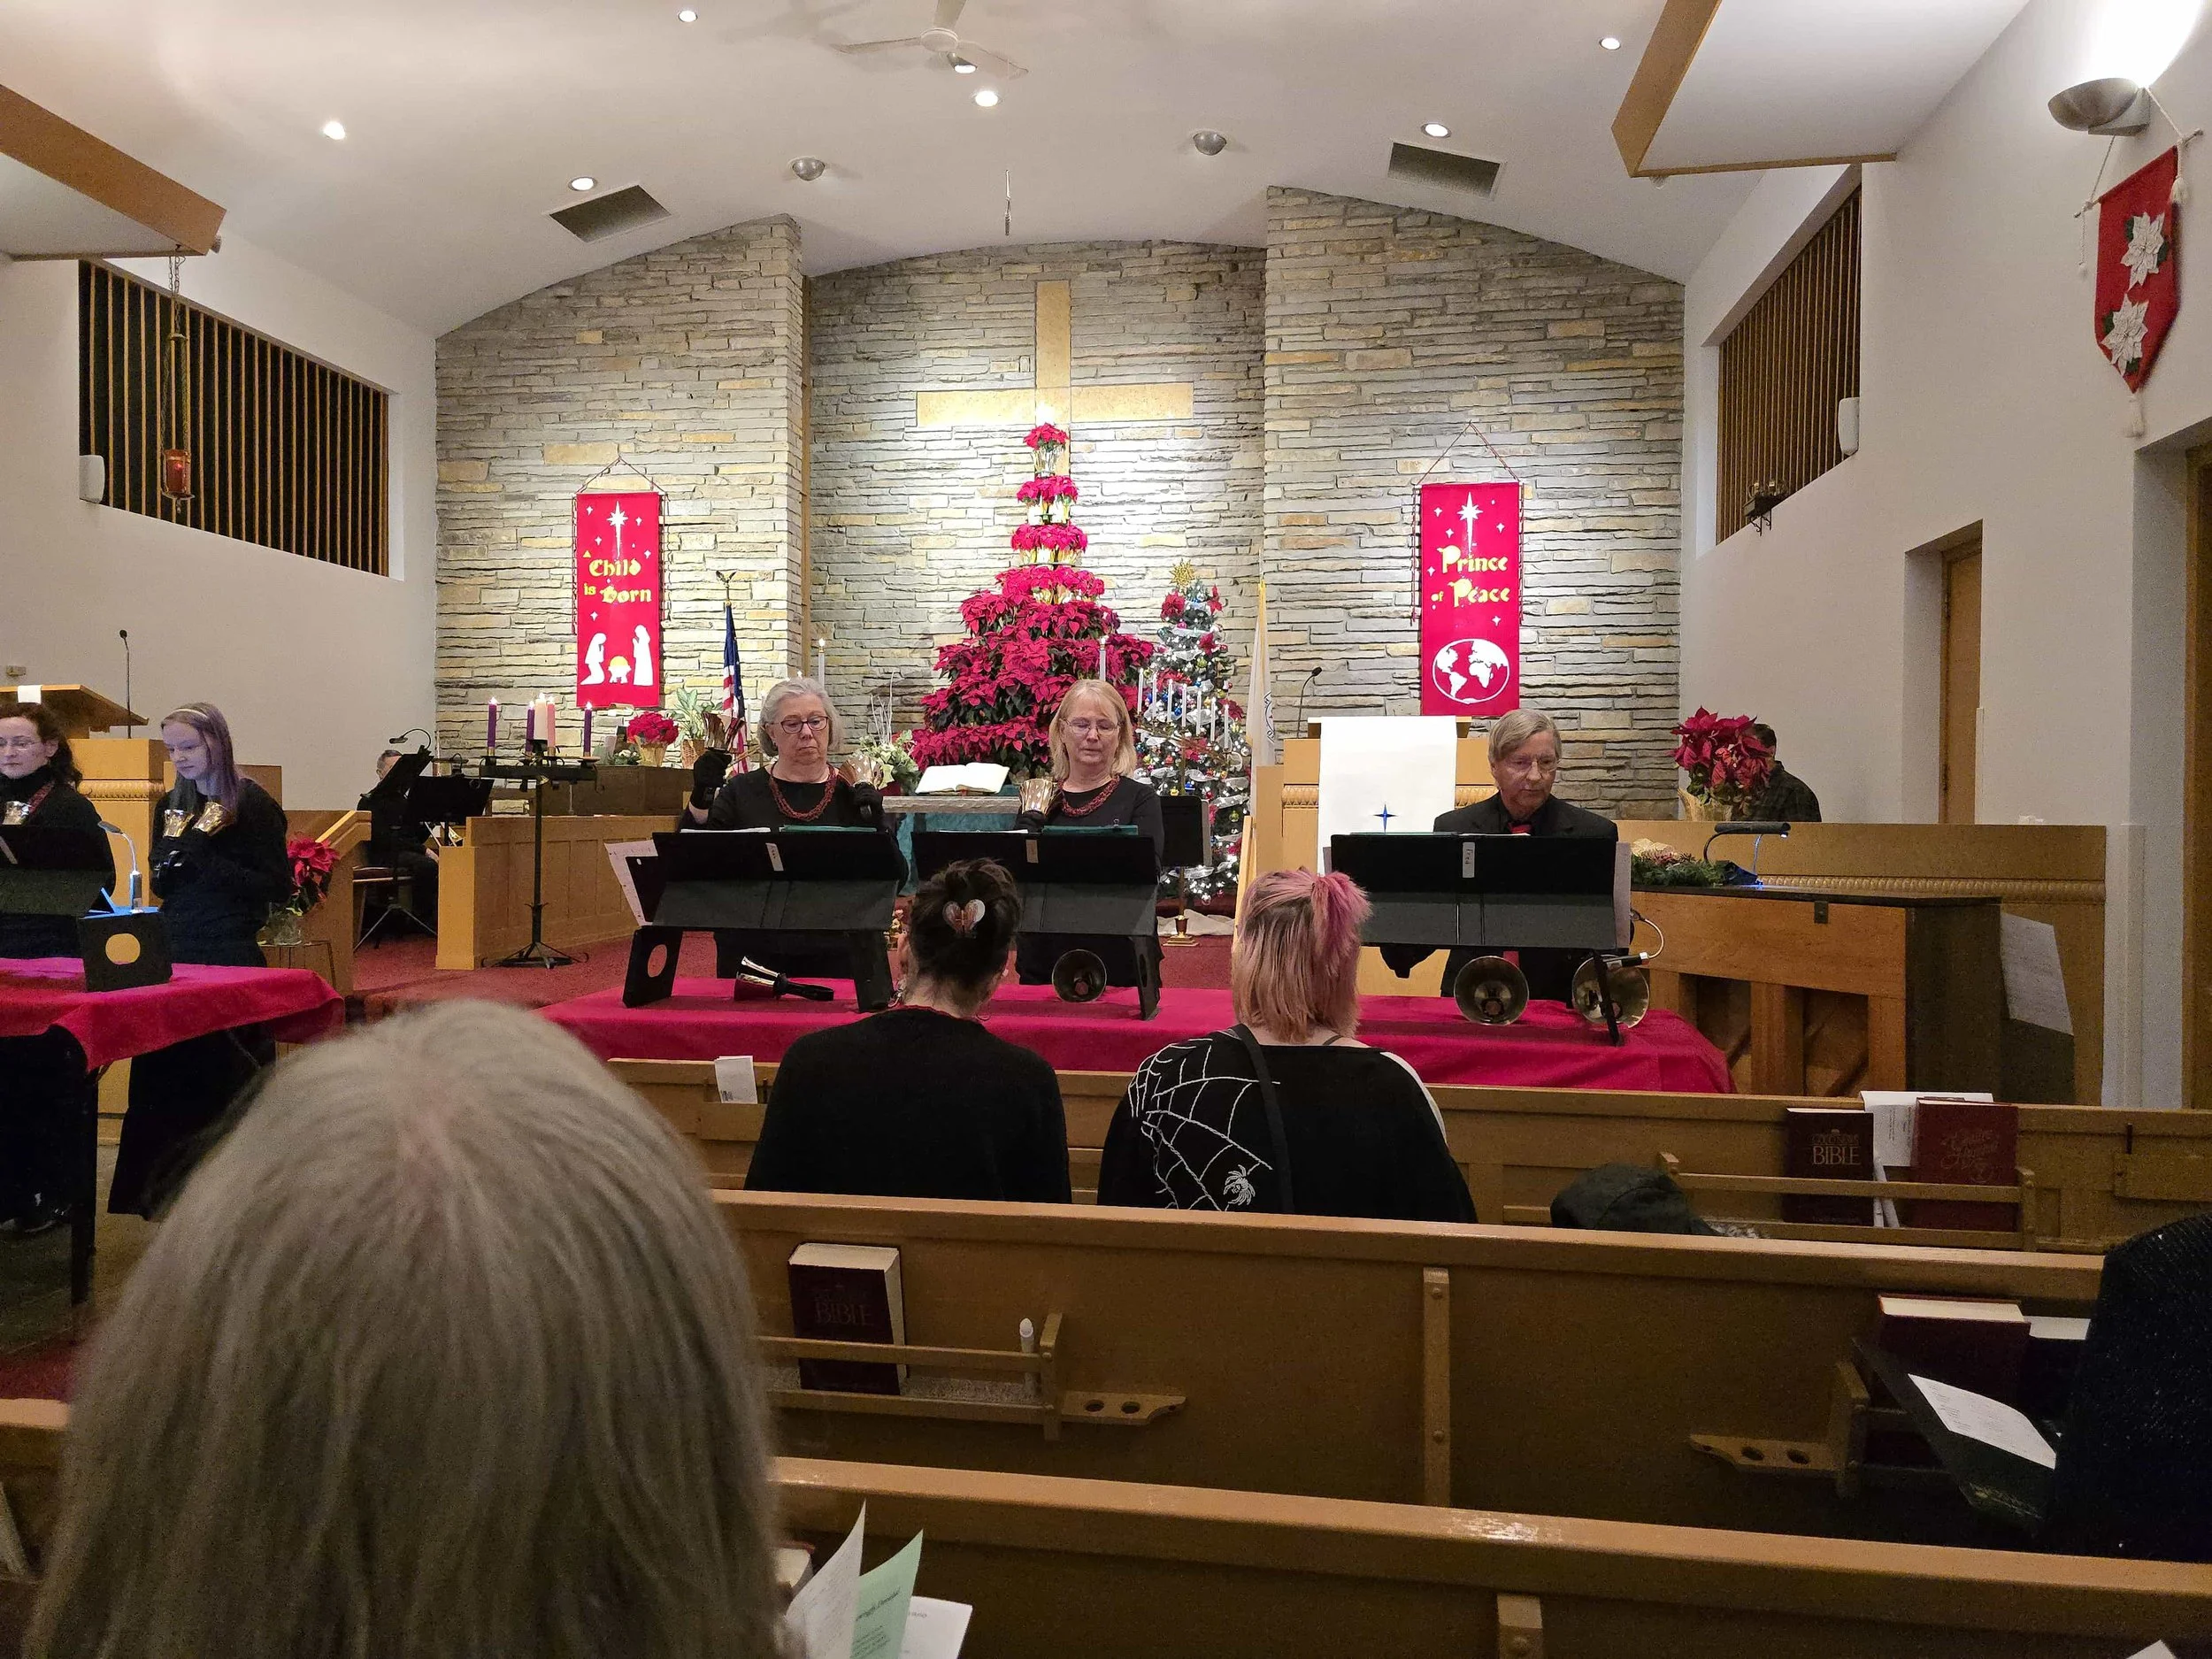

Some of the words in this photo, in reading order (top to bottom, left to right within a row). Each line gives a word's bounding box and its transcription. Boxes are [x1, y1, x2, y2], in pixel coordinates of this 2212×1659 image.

[589, 559, 641, 577] Child
[1437, 546, 1508, 573] Prince
[584, 583, 596, 595] is
[1431, 590, 1444, 602] of
[1448, 579, 1510, 607] Peace
[1812, 1146, 1861, 1165] BIBLE
